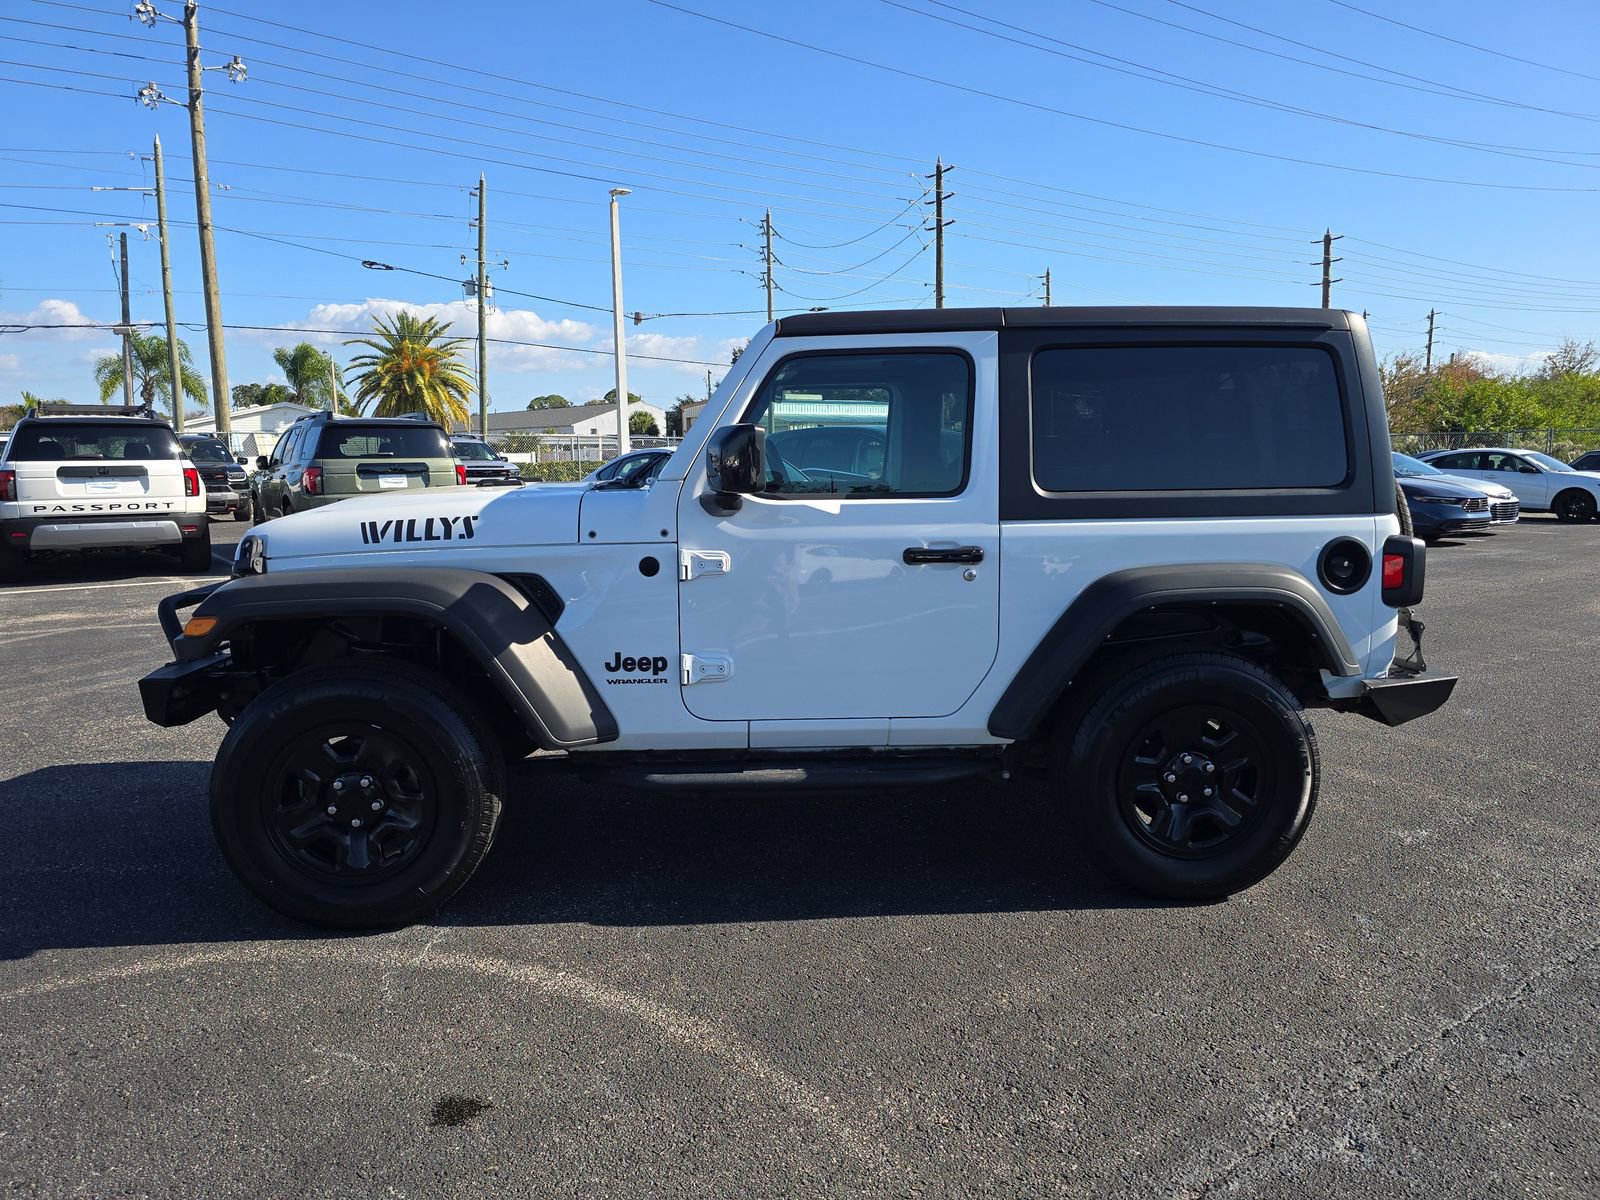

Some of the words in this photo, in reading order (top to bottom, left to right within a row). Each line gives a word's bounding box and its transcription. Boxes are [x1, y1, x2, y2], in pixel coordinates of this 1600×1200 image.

[33, 502, 174, 513] PASSPORT
[360, 515, 479, 544] WILLYS
[604, 652, 668, 675] Jeep
